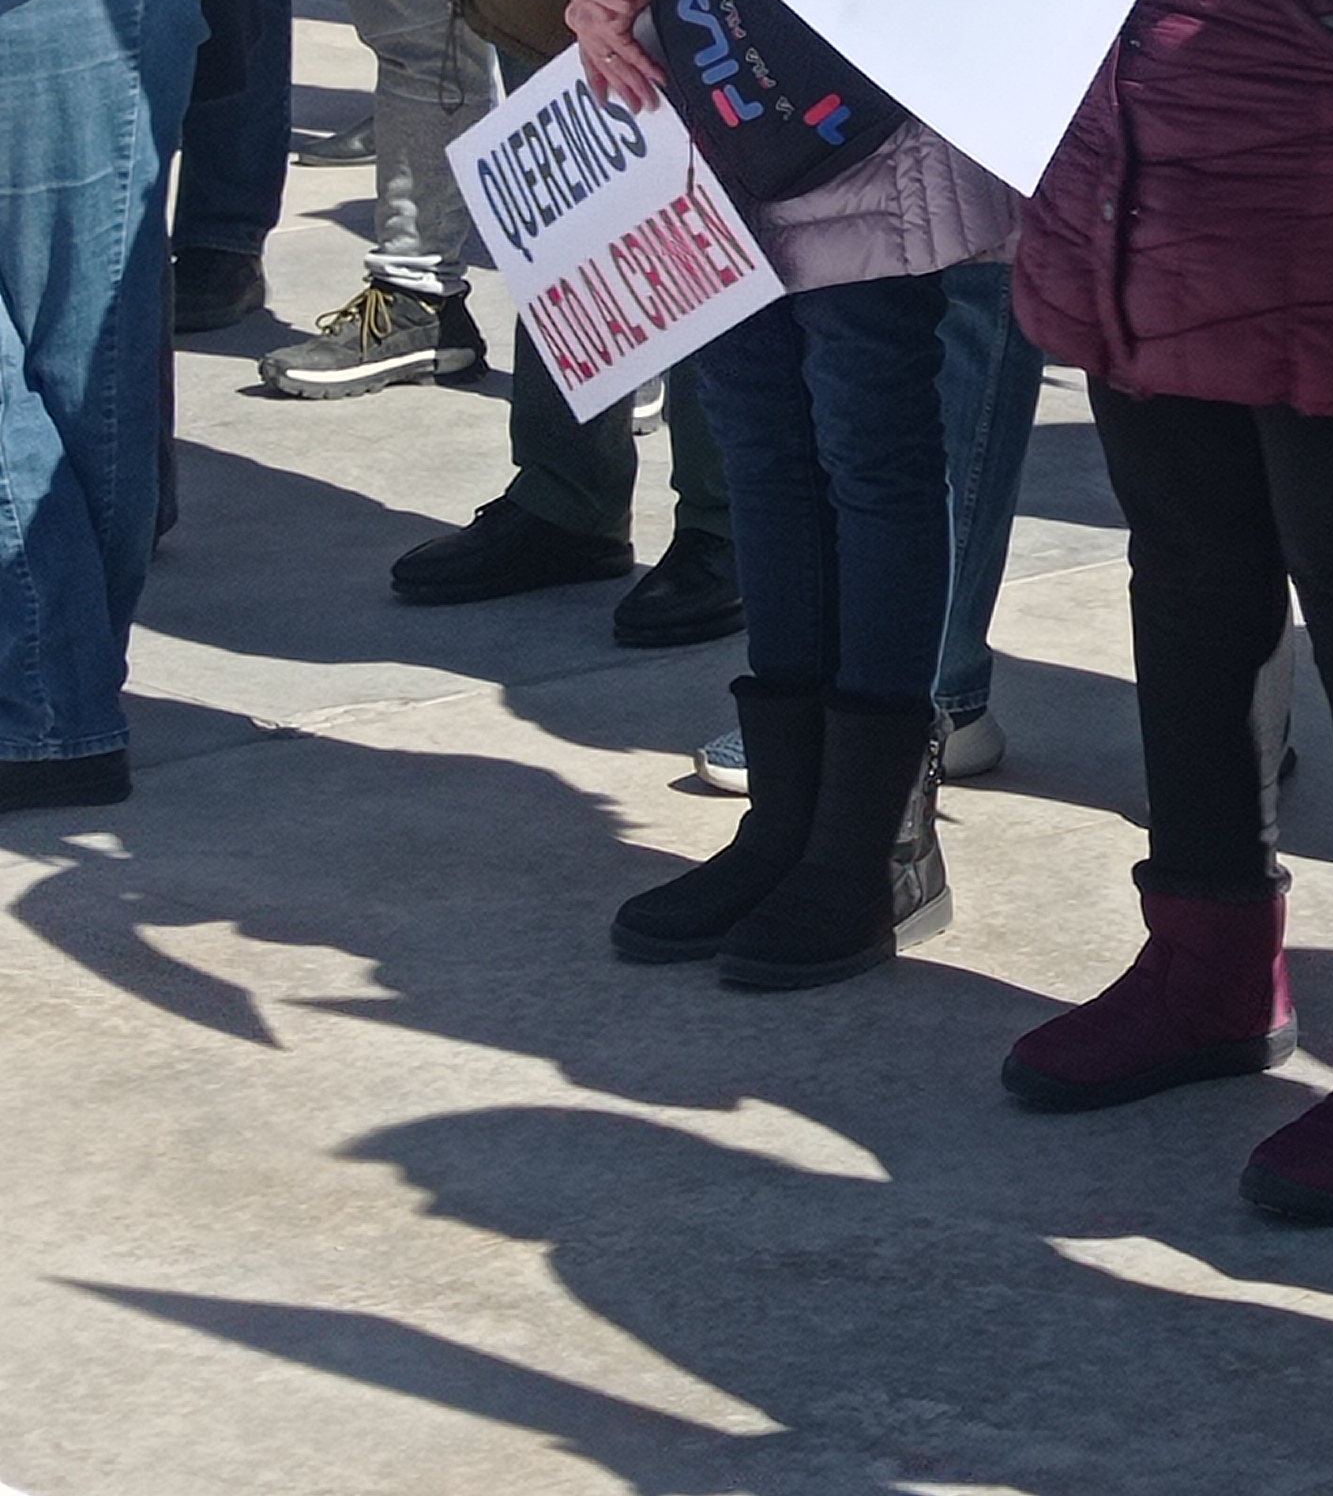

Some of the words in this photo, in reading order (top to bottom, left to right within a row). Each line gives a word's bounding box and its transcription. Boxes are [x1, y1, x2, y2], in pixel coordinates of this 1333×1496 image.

[476, 78, 648, 264] QUEREMOS
[577, 258, 649, 357] AL
[608, 183, 756, 331] CRIMEN
[527, 277, 613, 392] ALTO
